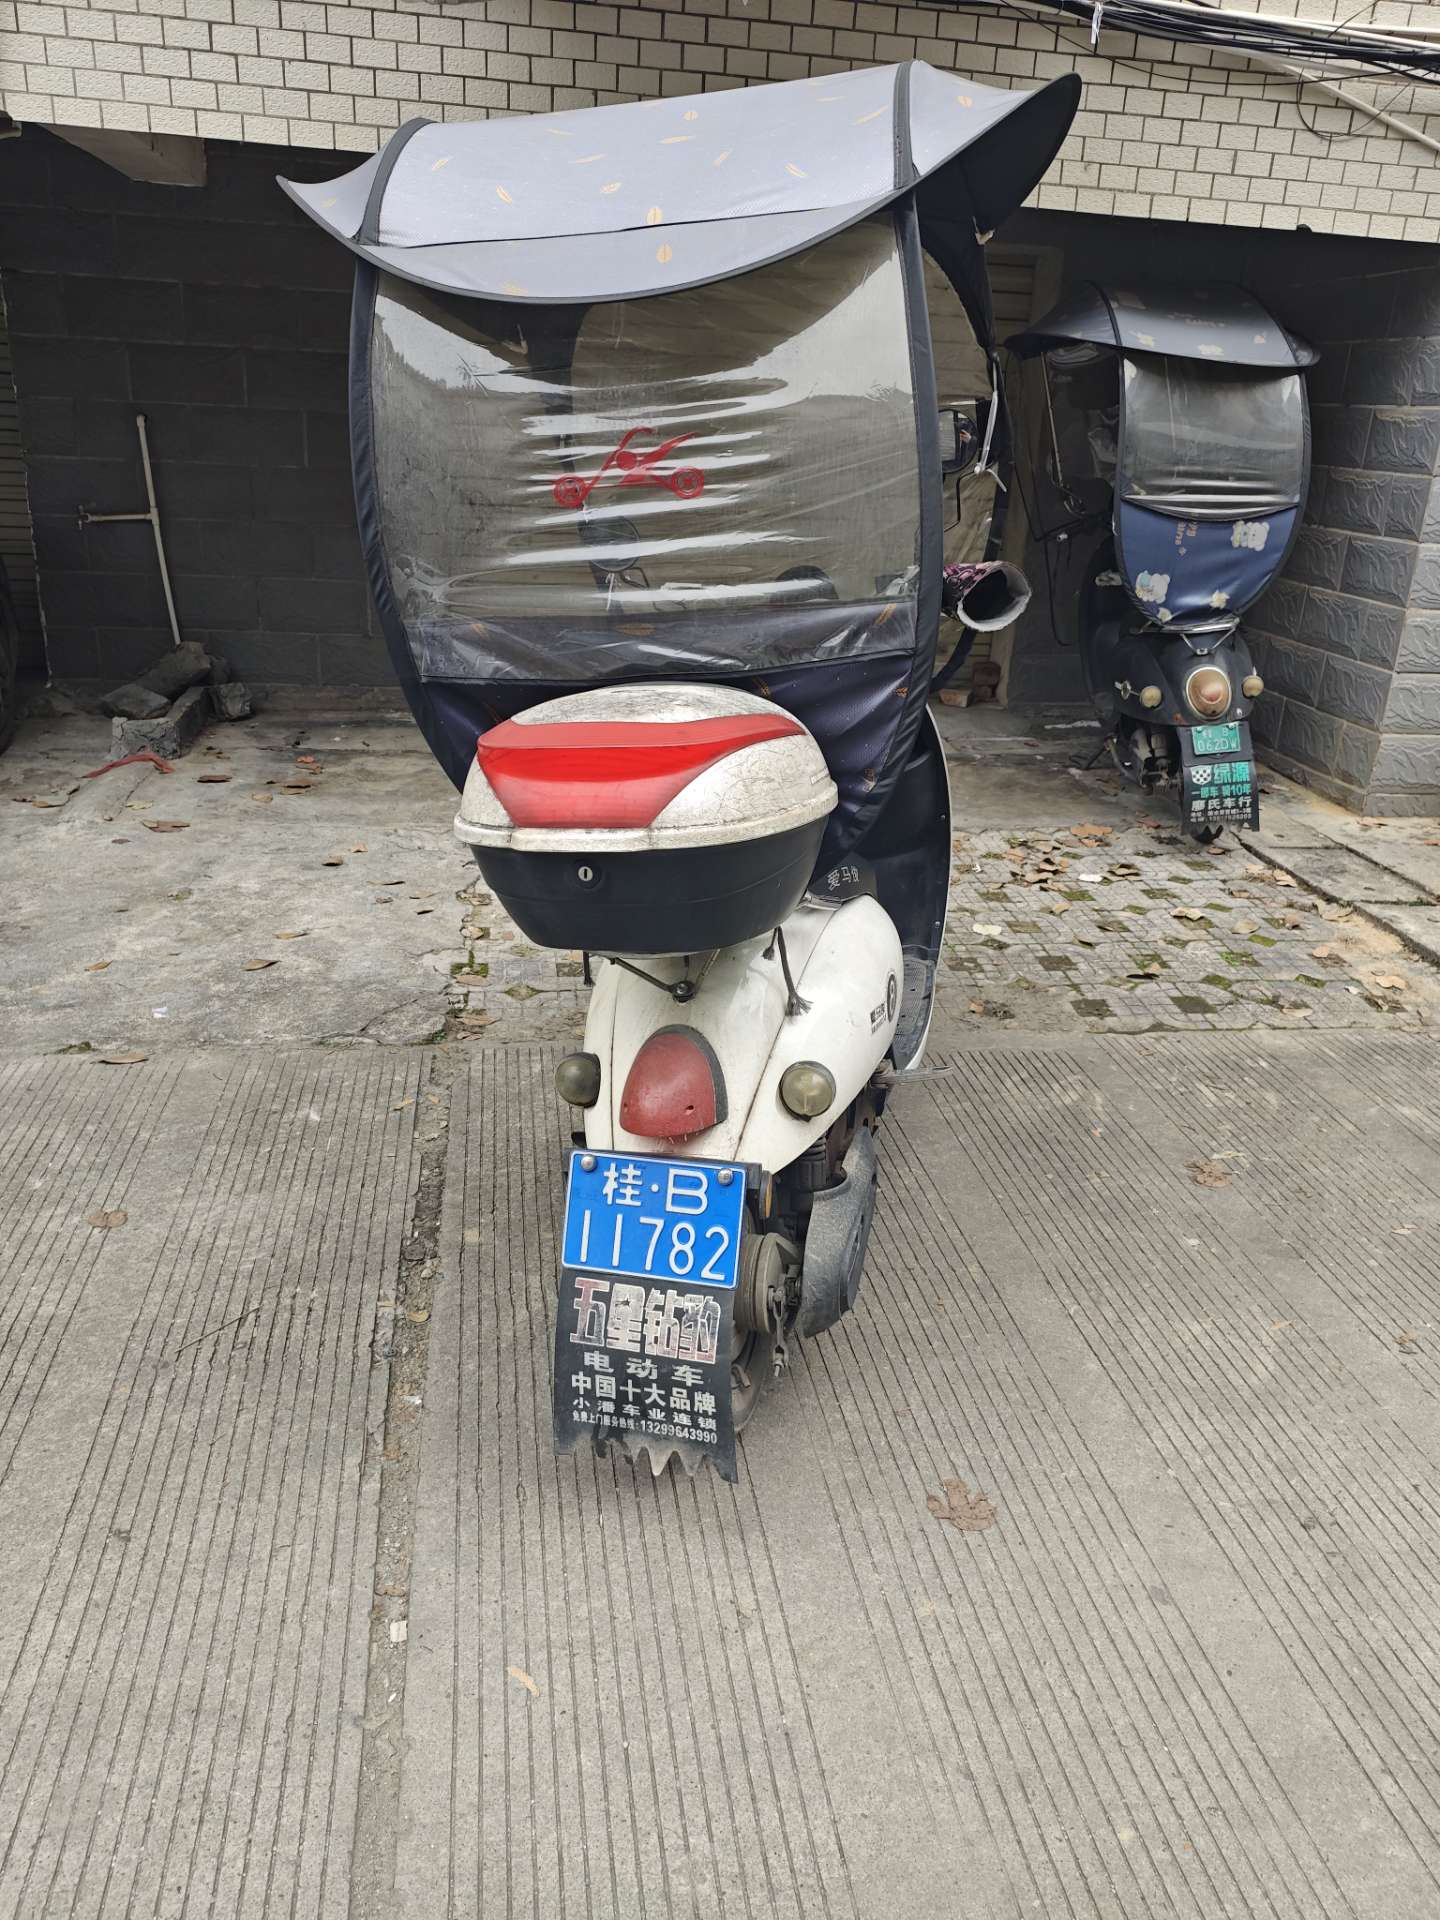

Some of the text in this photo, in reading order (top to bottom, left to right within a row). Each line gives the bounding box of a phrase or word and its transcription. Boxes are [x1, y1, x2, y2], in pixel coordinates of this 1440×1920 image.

[580, 1209, 729, 1281] 11782
[570, 1277, 721, 1364] 五星钻豹
[571, 1371, 717, 1416] 中国十大品牌
[583, 1350, 705, 1387] 电动车
